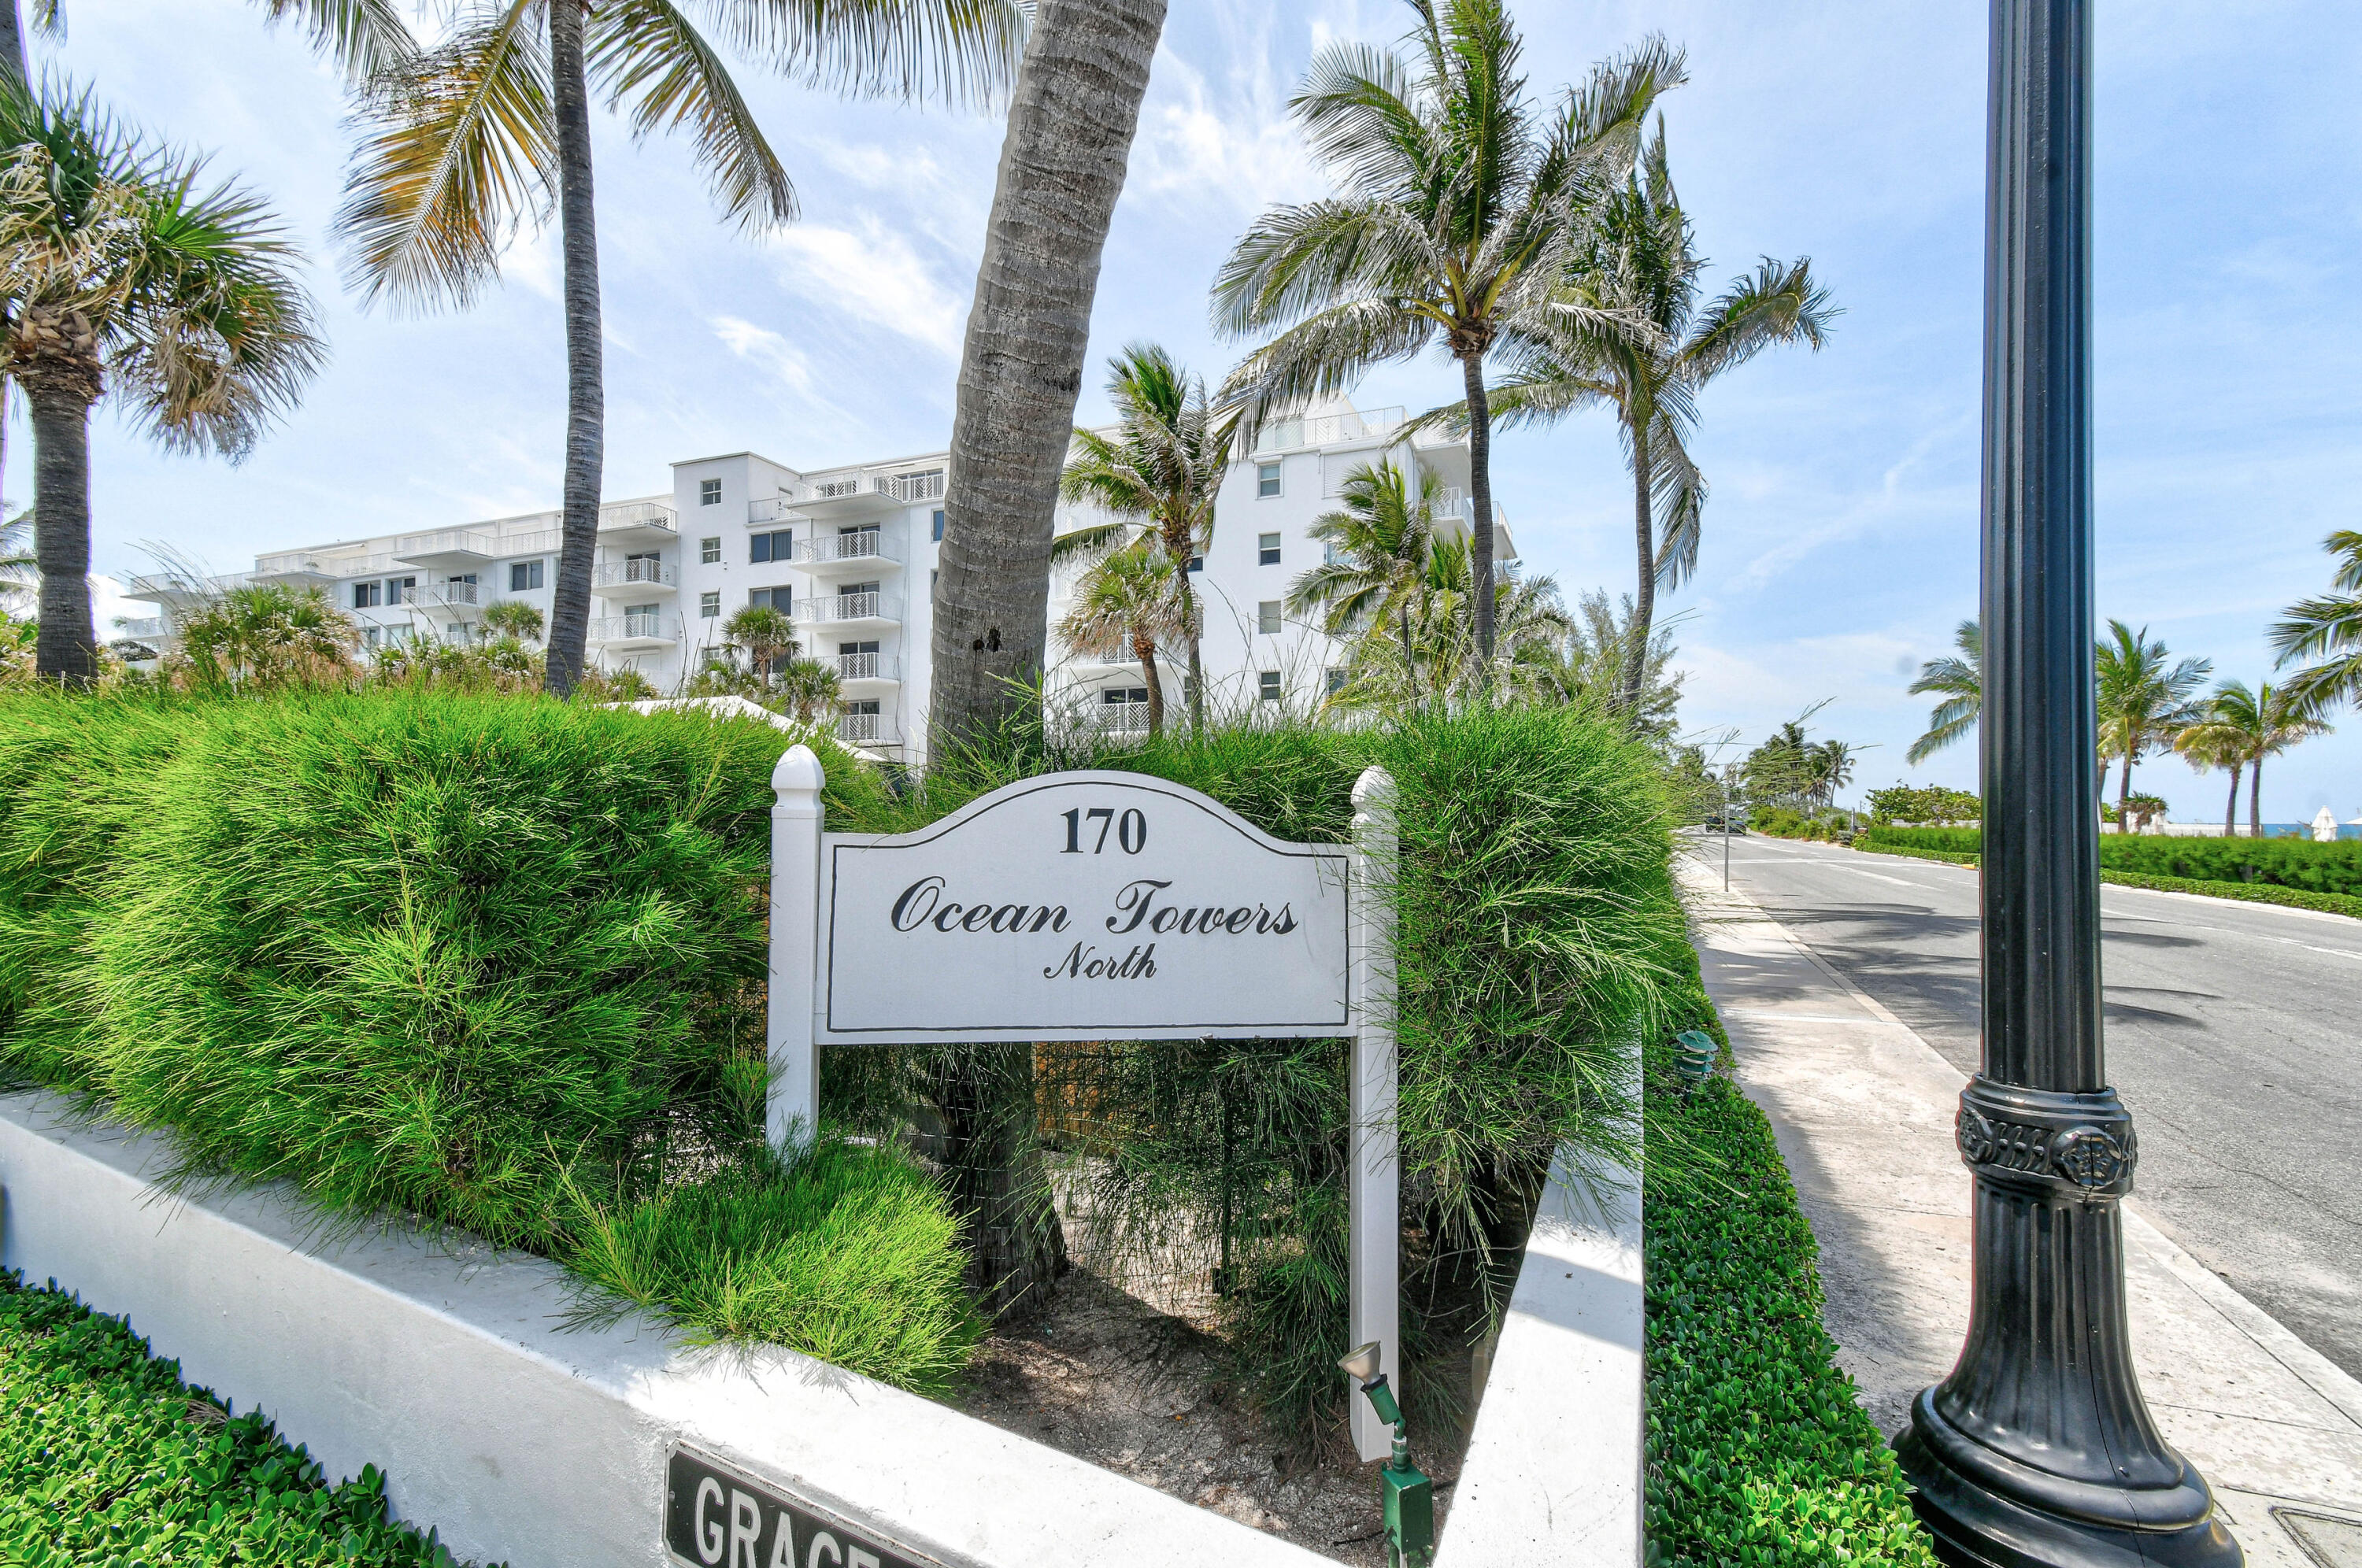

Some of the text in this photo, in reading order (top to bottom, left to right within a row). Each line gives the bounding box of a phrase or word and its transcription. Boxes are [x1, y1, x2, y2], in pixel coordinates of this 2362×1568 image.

[1060, 808, 1147, 855] 170
[890, 875, 1299, 935] Ocean Towers
[1043, 941, 1157, 980] North
[694, 1477, 879, 1568] GRA
